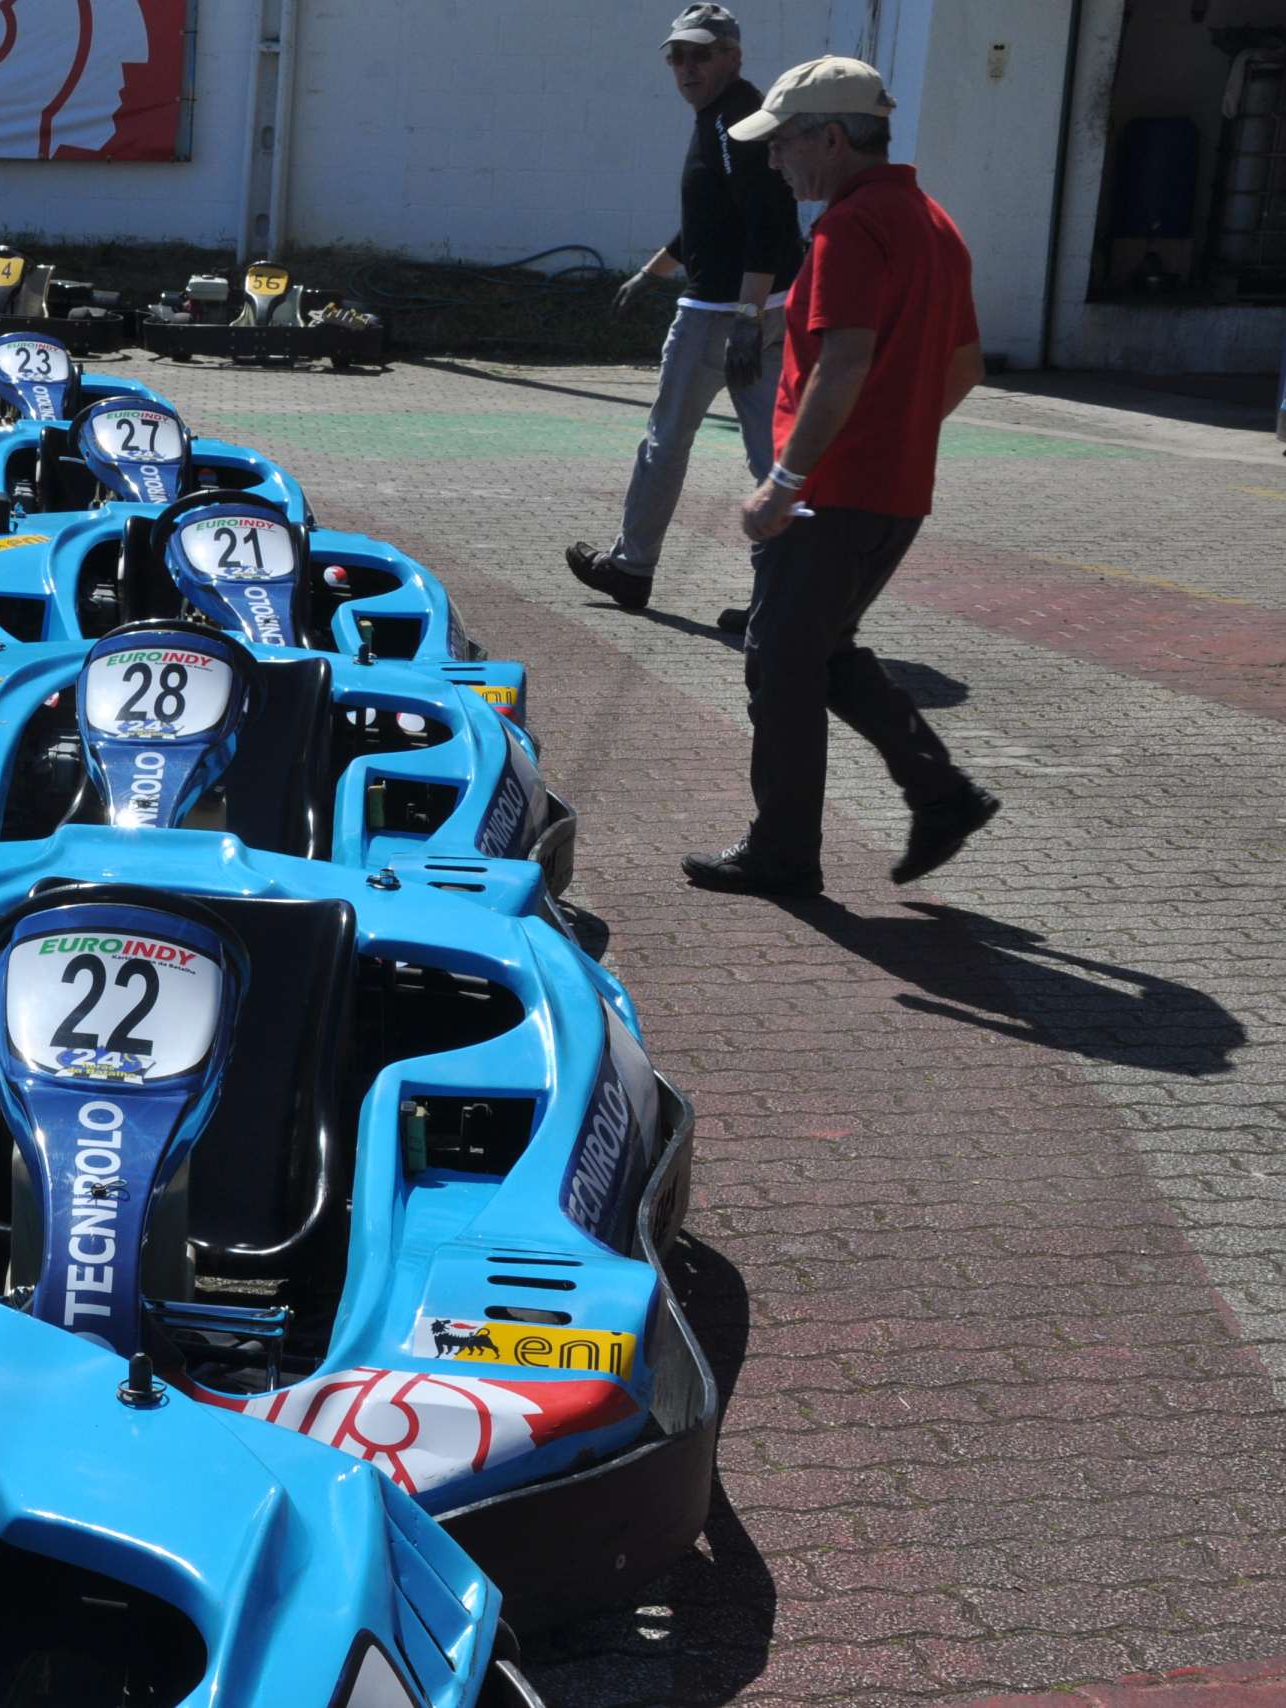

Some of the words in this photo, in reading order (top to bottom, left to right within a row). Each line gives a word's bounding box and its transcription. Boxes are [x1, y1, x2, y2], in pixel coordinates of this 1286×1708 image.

[252, 274, 281, 290] 56
[16, 347, 52, 375] 23
[116, 418, 159, 452] 27
[196, 518, 275, 531] EUROINDY
[213, 527, 264, 568] 21
[106, 651, 214, 667] EUROINDY
[115, 662, 188, 722] 28
[38, 937, 197, 967] EUROINDY
[50, 953, 160, 1056] 22
[70, 1048, 124, 1068] 24
[63, 1100, 125, 1325] TECNIROLO
[513, 1331, 622, 1373] eni
